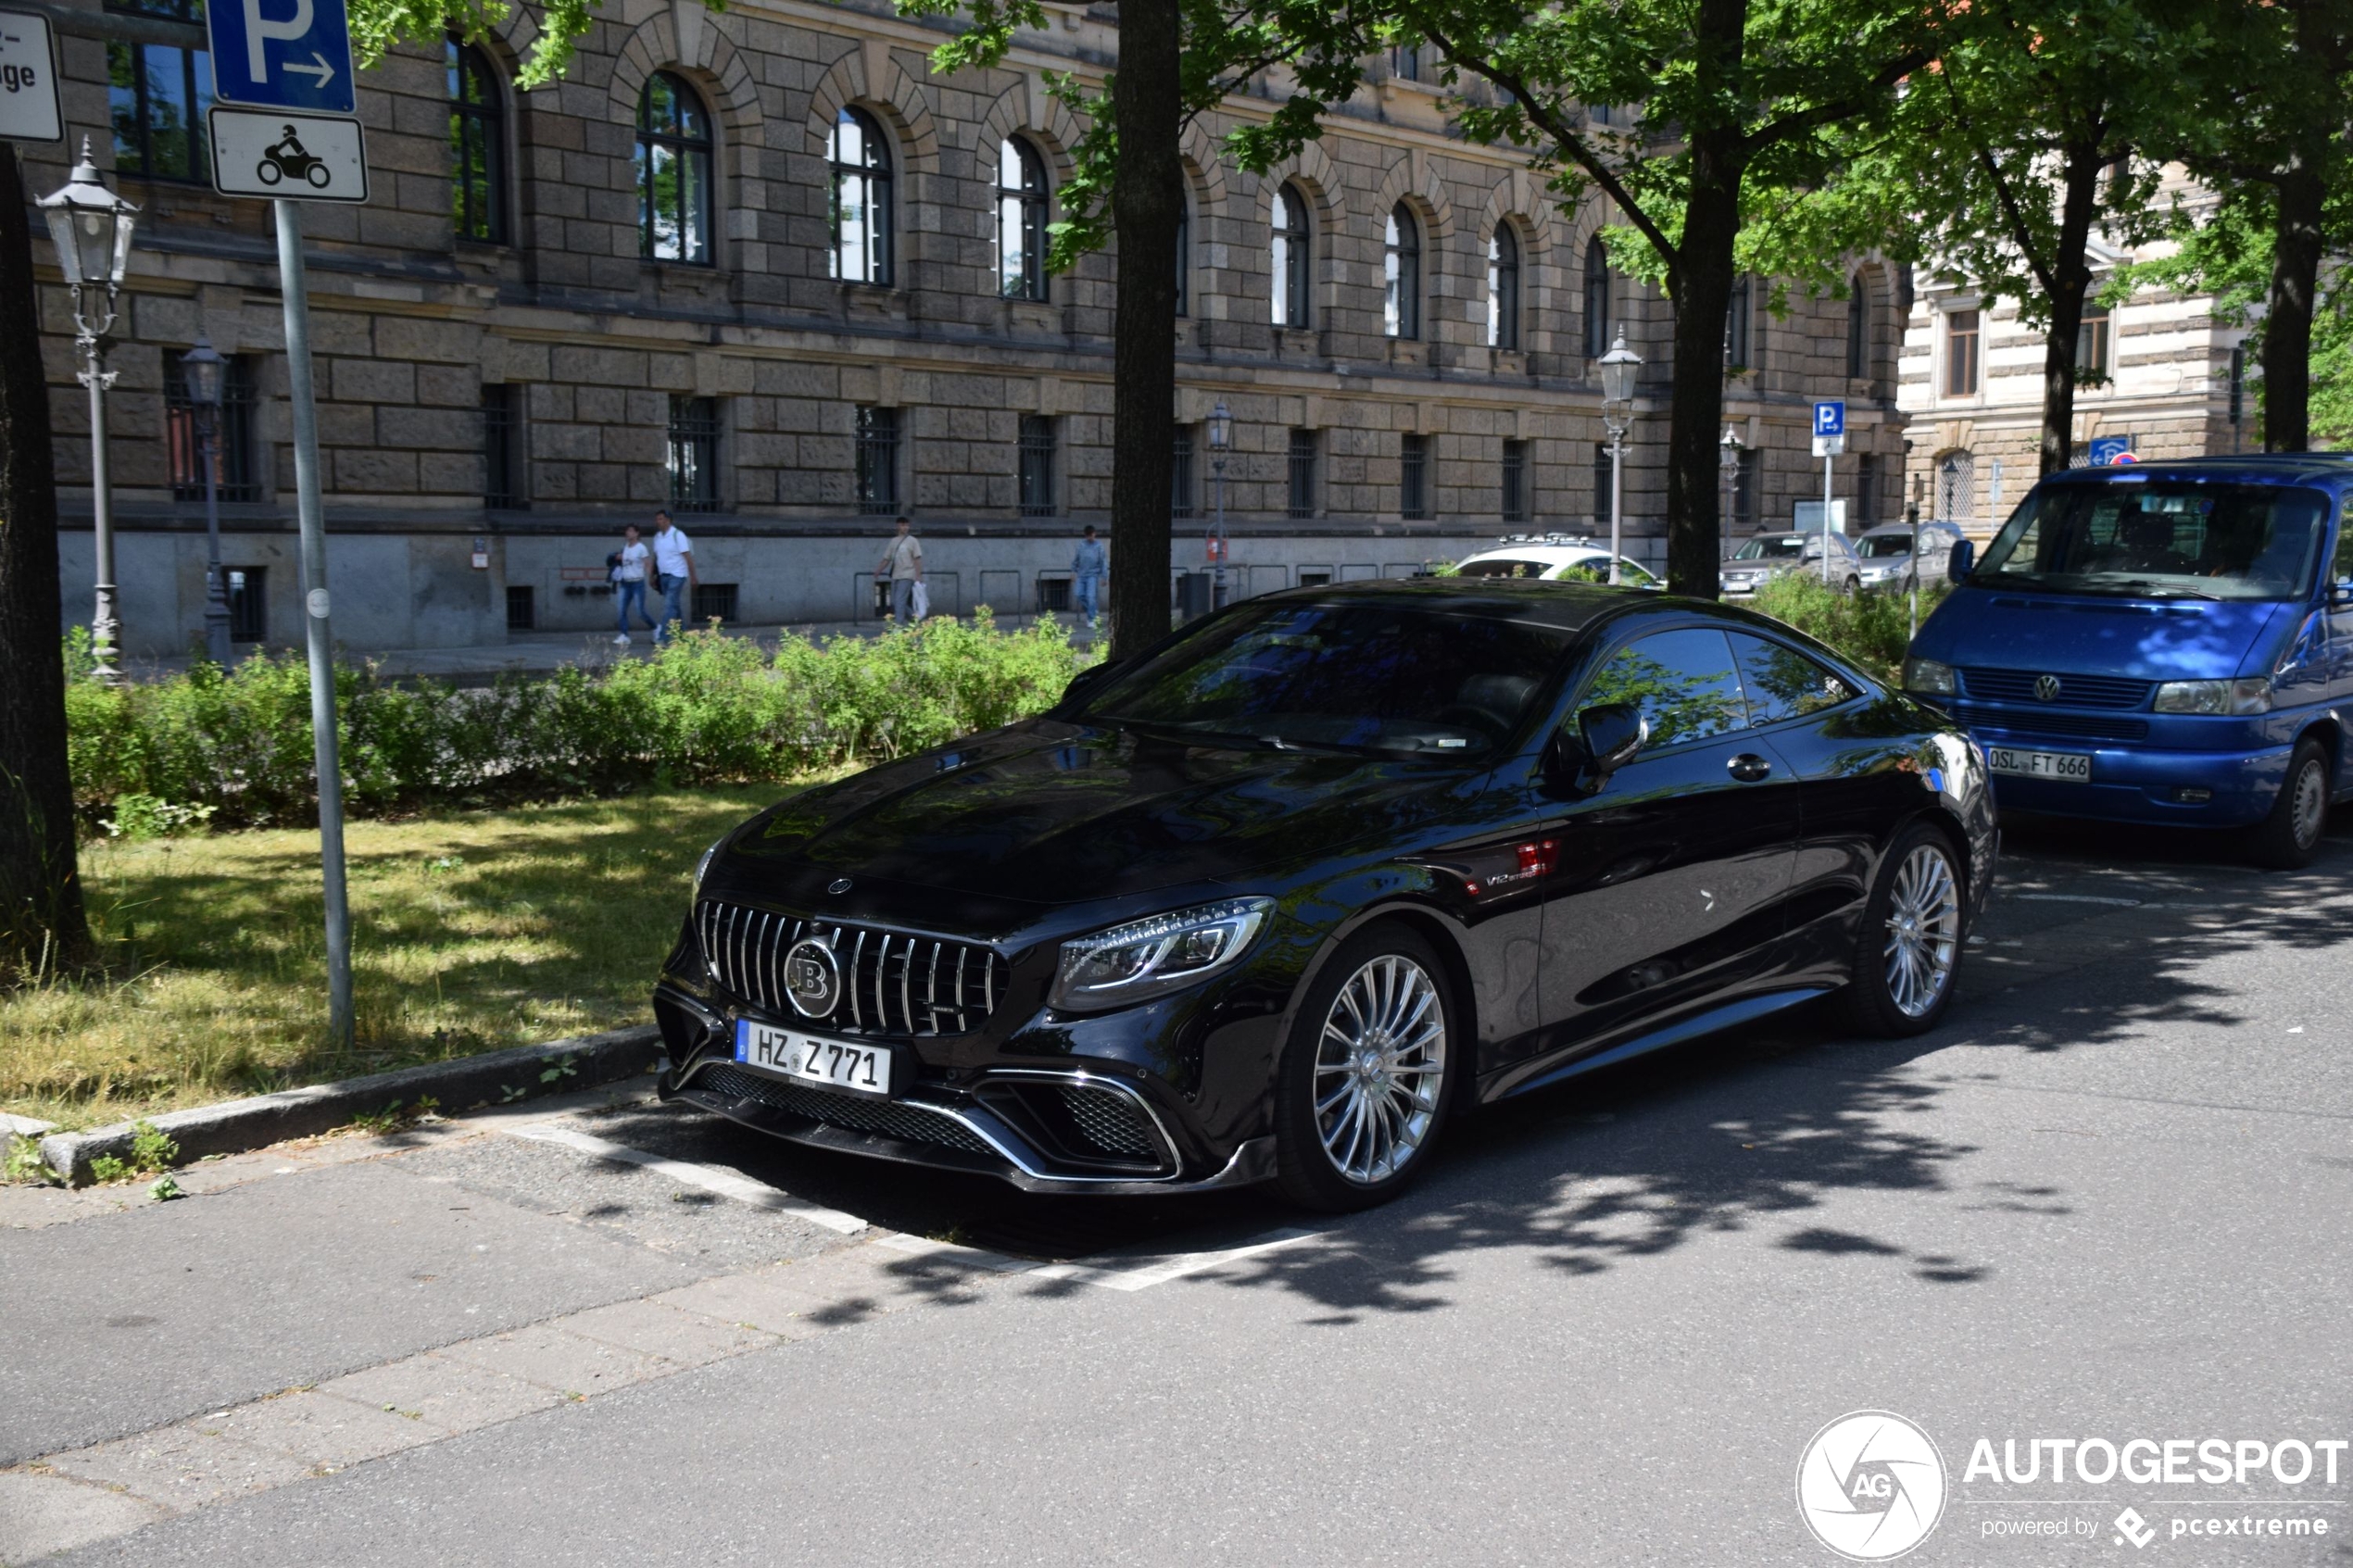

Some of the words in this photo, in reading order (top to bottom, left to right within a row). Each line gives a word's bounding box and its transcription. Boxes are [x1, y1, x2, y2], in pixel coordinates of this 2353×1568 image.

[243, 0, 315, 83] P
[0, 64, 35, 94] ge
[1818, 406, 1836, 433] P
[1990, 750, 2019, 770] OSL
[2032, 754, 2052, 772] FT
[2057, 757, 2087, 776] 666
[1486, 873, 1508, 886] V12
[797, 958, 827, 999] B
[739, 1045, 746, 1055] D
[758, 1029, 787, 1068] HZ
[805, 1040, 822, 1075] Z
[827, 1044, 877, 1086] 771
